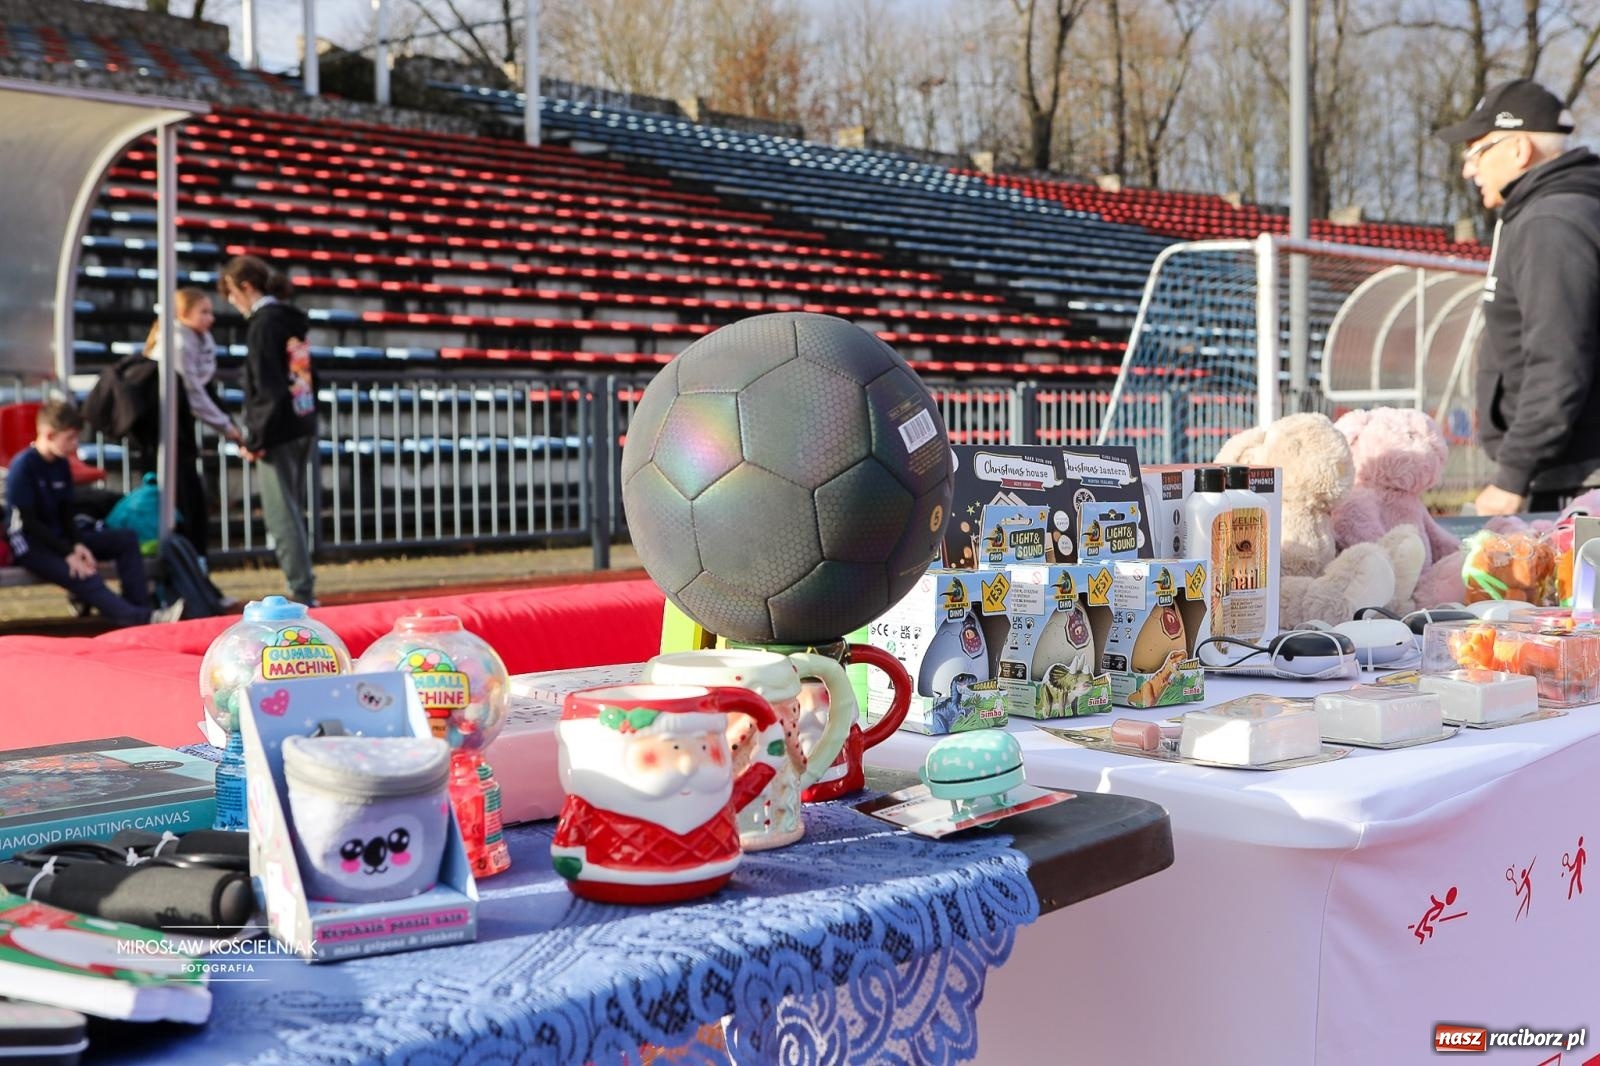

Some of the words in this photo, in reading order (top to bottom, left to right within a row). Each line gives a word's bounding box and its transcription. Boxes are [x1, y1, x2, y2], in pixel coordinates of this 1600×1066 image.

[984, 461, 1024, 476] Christmas
[1026, 468, 1048, 478] house
[1100, 466, 1126, 476] lantern
[1112, 537, 1136, 551] SOUND
[1017, 545, 1043, 558] SOUND
[1189, 569, 1204, 594] TEST
[1231, 569, 1258, 590] nail
[986, 578, 1006, 607] TEST
[1092, 575, 1111, 599] TEST
[950, 610, 963, 618] DINO
[269, 647, 332, 661] GUMBALL
[269, 661, 336, 675] MACHINE
[415, 675, 464, 688] MBALL
[0, 830, 62, 850] IAMOND
[65, 819, 131, 839] PAINTING
[134, 810, 190, 828] CANVAS
